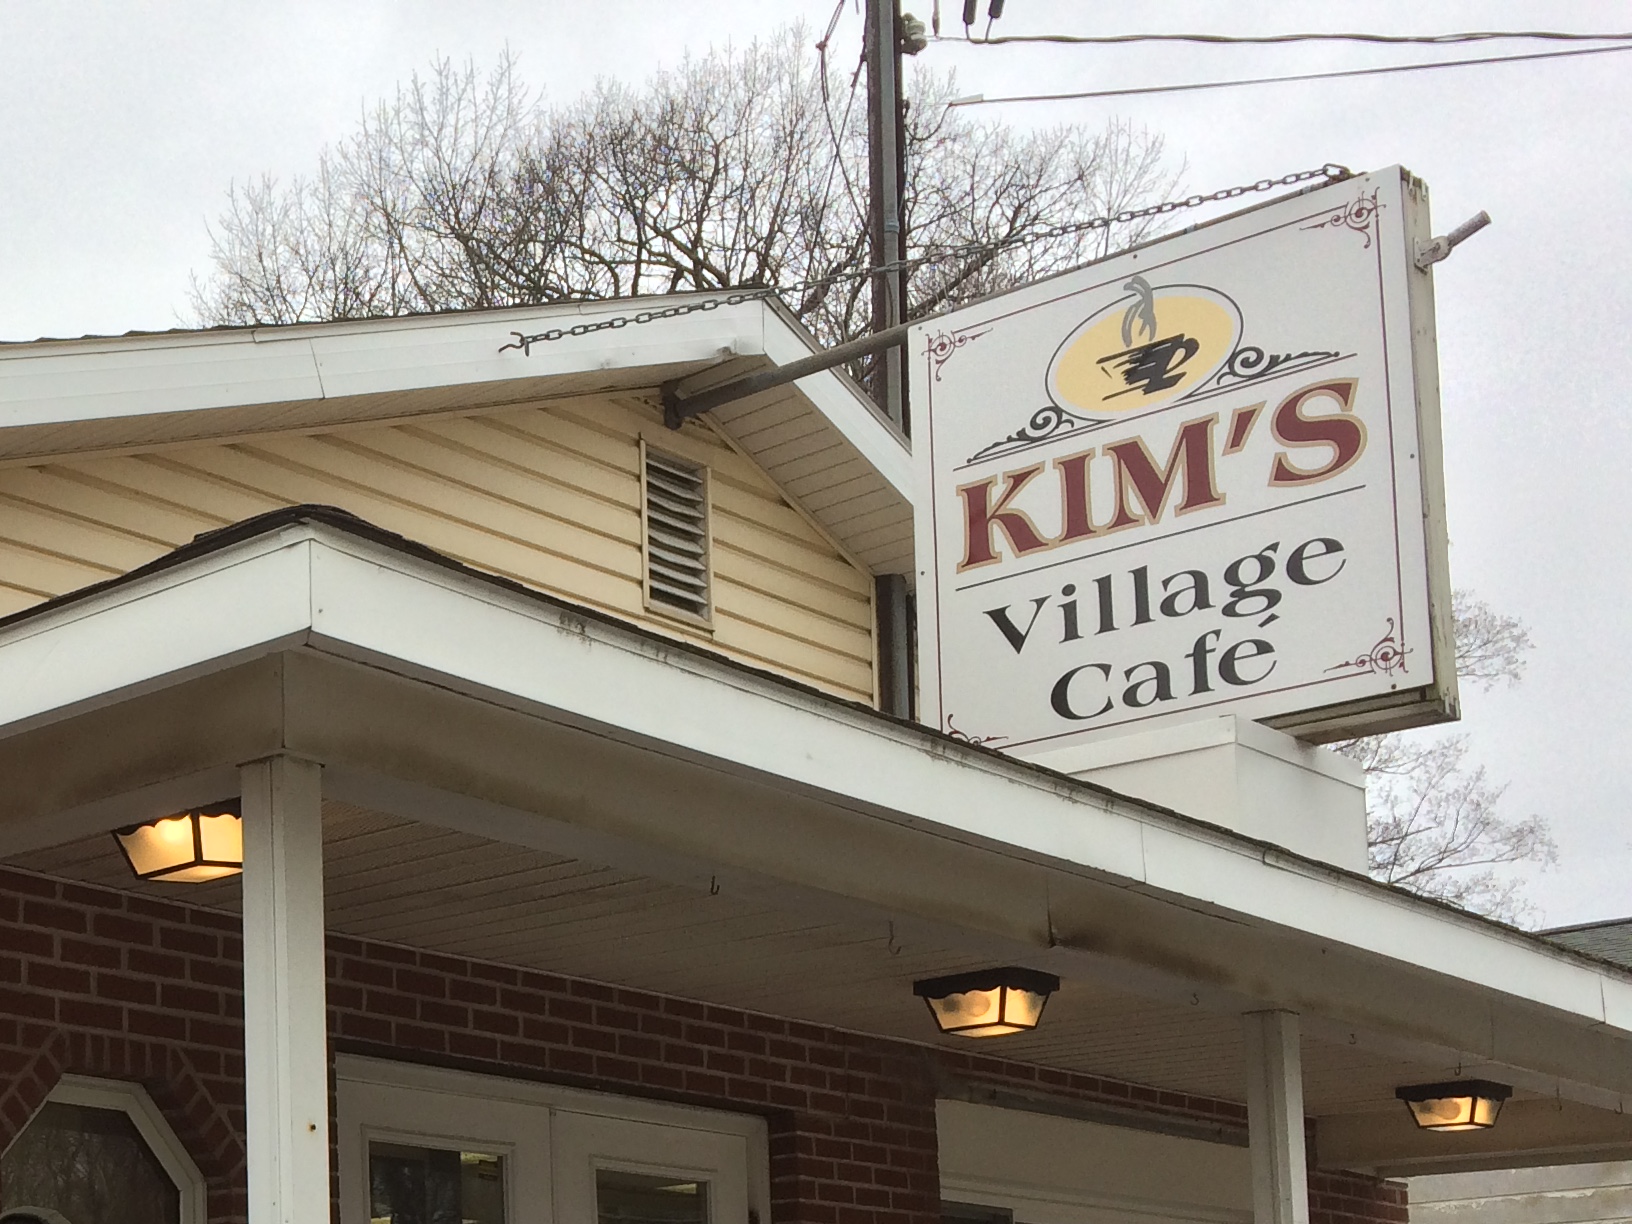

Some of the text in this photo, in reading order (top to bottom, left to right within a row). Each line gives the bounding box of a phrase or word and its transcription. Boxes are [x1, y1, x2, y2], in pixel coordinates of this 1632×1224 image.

[955, 377, 1368, 574] KIM'S
[982, 536, 1347, 655] Village
[1050, 613, 1277, 721] Café
